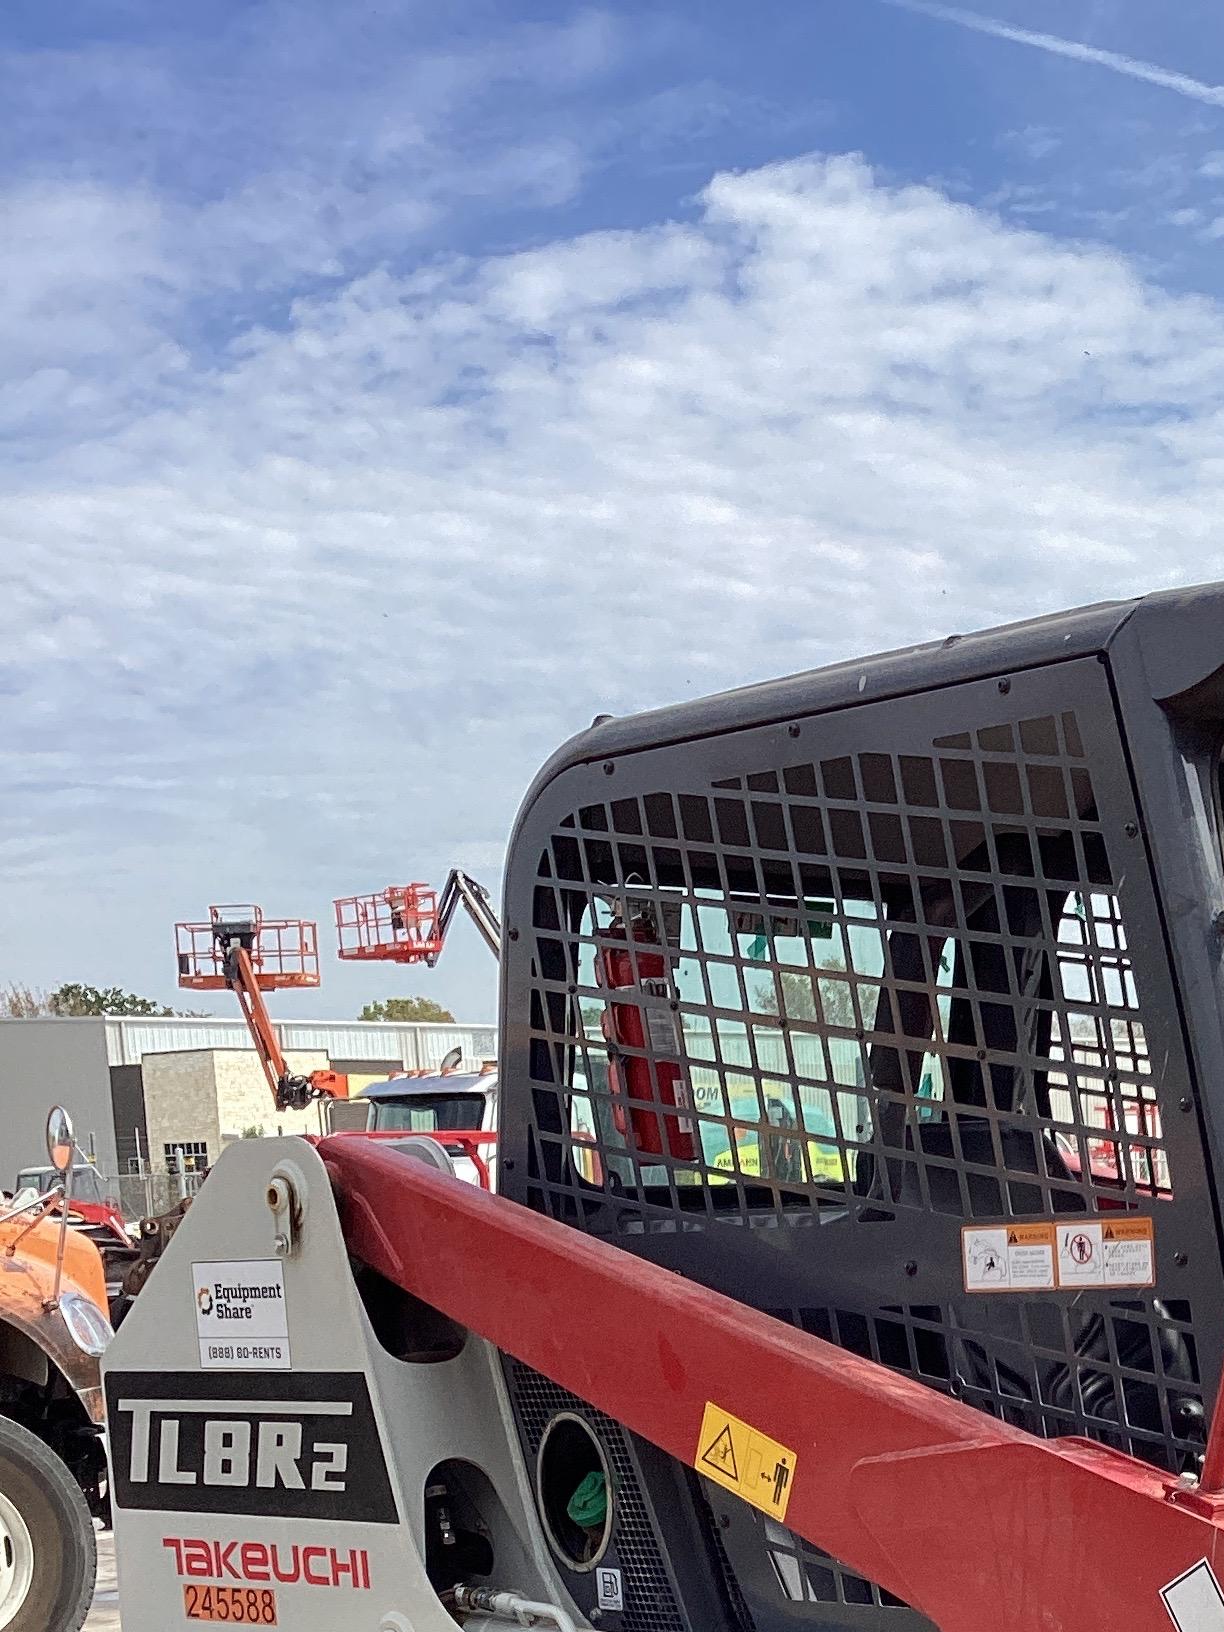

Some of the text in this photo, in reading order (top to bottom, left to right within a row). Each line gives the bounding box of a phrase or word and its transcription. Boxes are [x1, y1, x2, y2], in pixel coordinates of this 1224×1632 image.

[214, 1283, 282, 1303] Equipment
[216, 1303, 253, 1319] Share
[208, 1346, 282, 1360] (888) 80-RENTS
[186, 1584, 276, 1625] 245588
